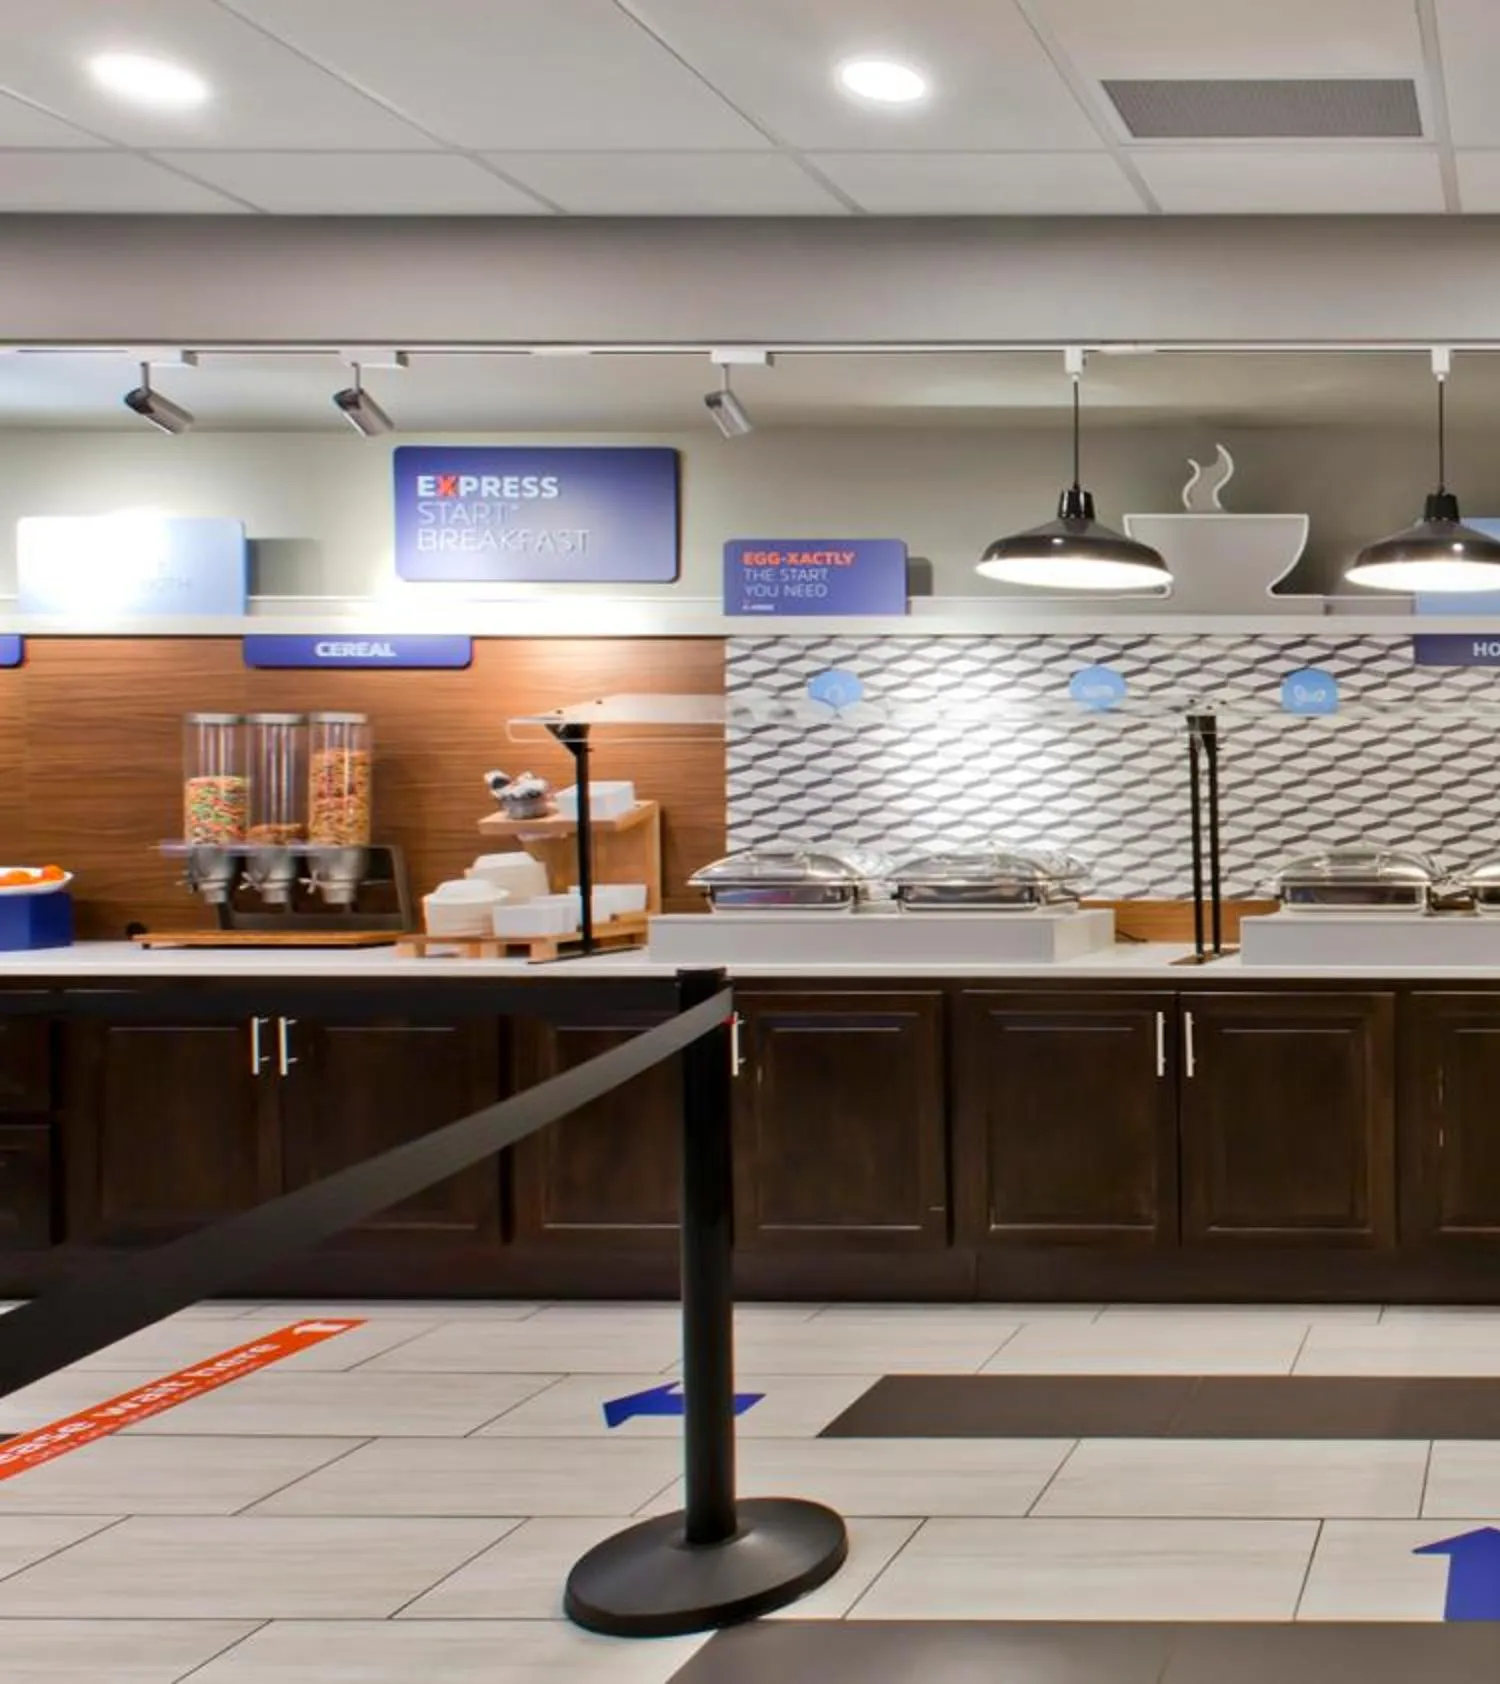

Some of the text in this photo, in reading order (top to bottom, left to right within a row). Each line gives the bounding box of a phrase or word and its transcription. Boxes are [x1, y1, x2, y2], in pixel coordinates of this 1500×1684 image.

[416, 475, 559, 498] EXPRESS
[417, 502, 512, 525] START
[417, 528, 590, 553] BREAKFAST
[742, 551, 856, 566] EGG-XACTLY
[744, 568, 829, 582] THE START
[744, 584, 828, 598] YOU NEED
[314, 641, 398, 657] CEREAL
[94, 1379, 195, 1418] wait
[183, 1343, 282, 1379] here
